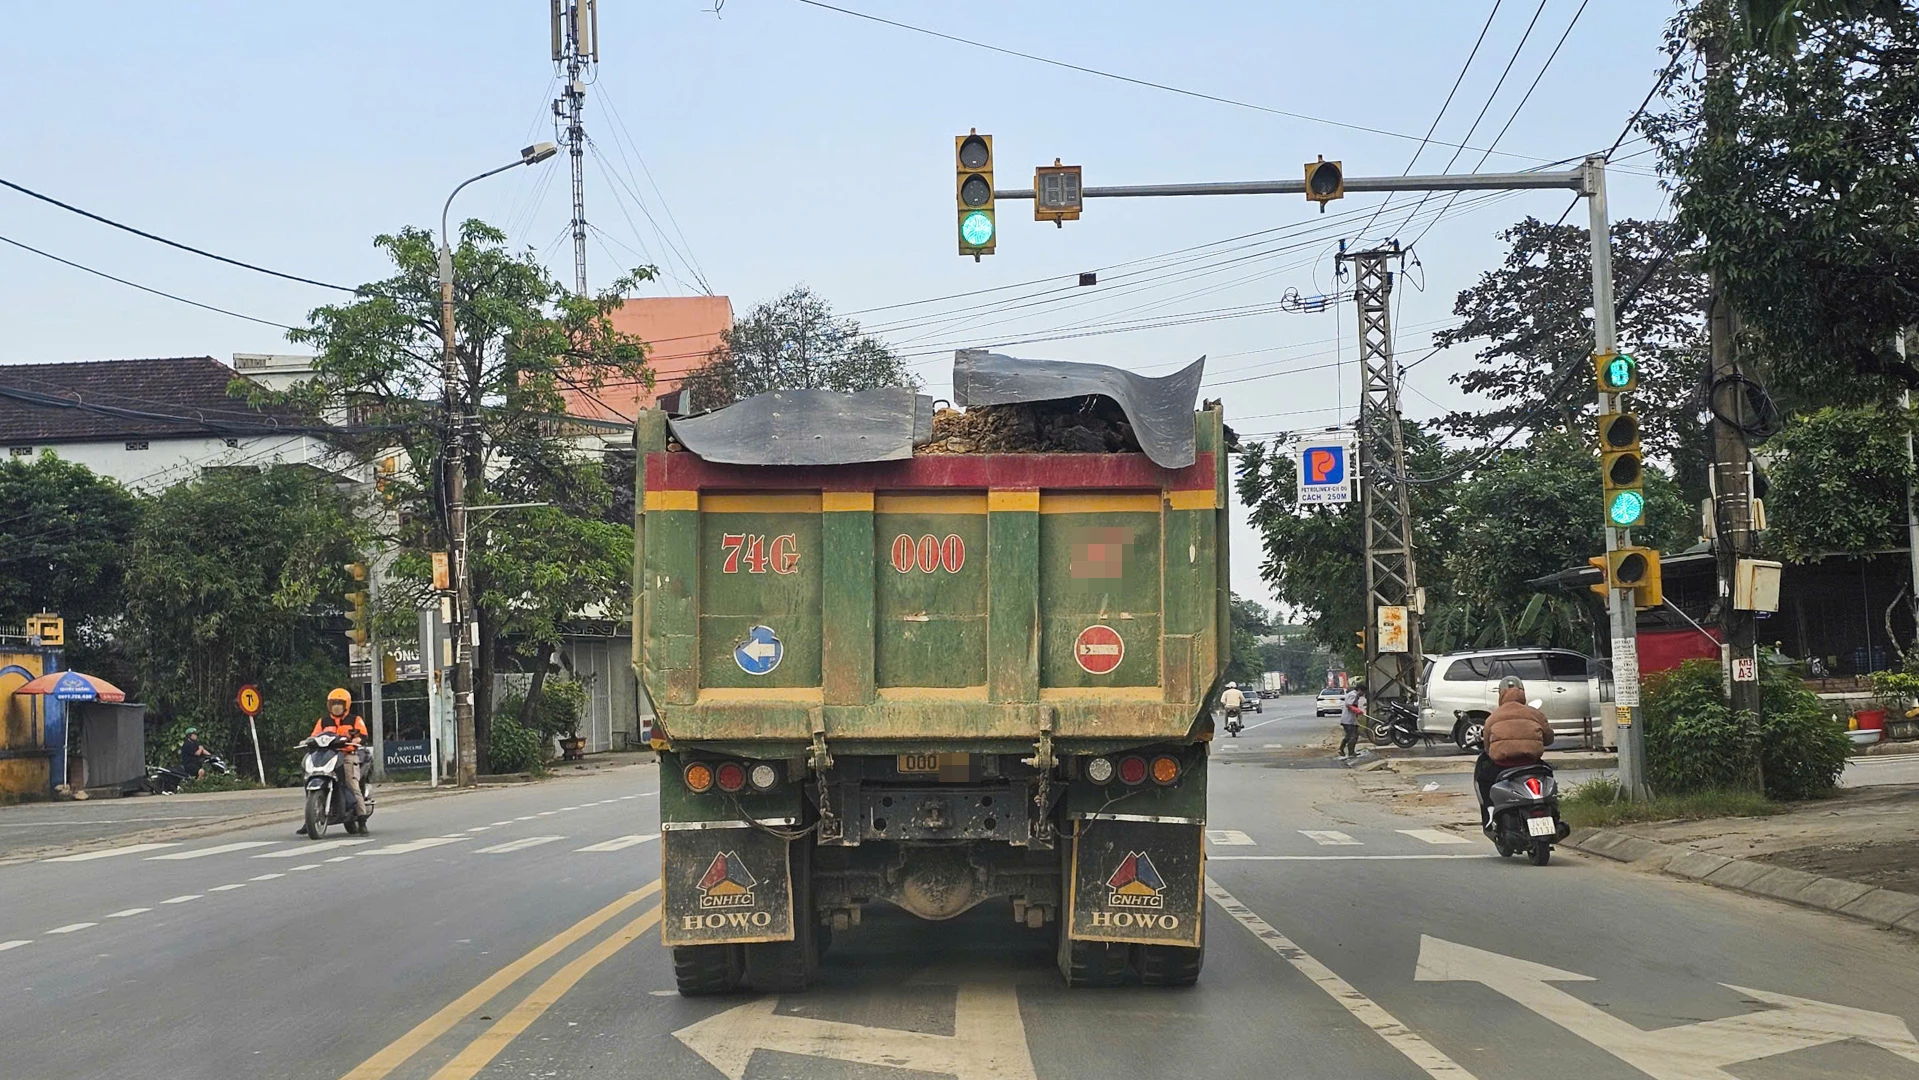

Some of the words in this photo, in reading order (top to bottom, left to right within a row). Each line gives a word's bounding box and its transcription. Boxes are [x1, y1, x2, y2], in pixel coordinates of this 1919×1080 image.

[721, 533, 801, 575] 74G
[891, 533, 965, 574] 000
[1738, 659, 1753, 667] KM3
[702, 894, 752, 907] CNHTC
[1111, 894, 1160, 906] CNHTC
[682, 911, 772, 930] HOWO
[1090, 911, 1179, 930] HOWO
